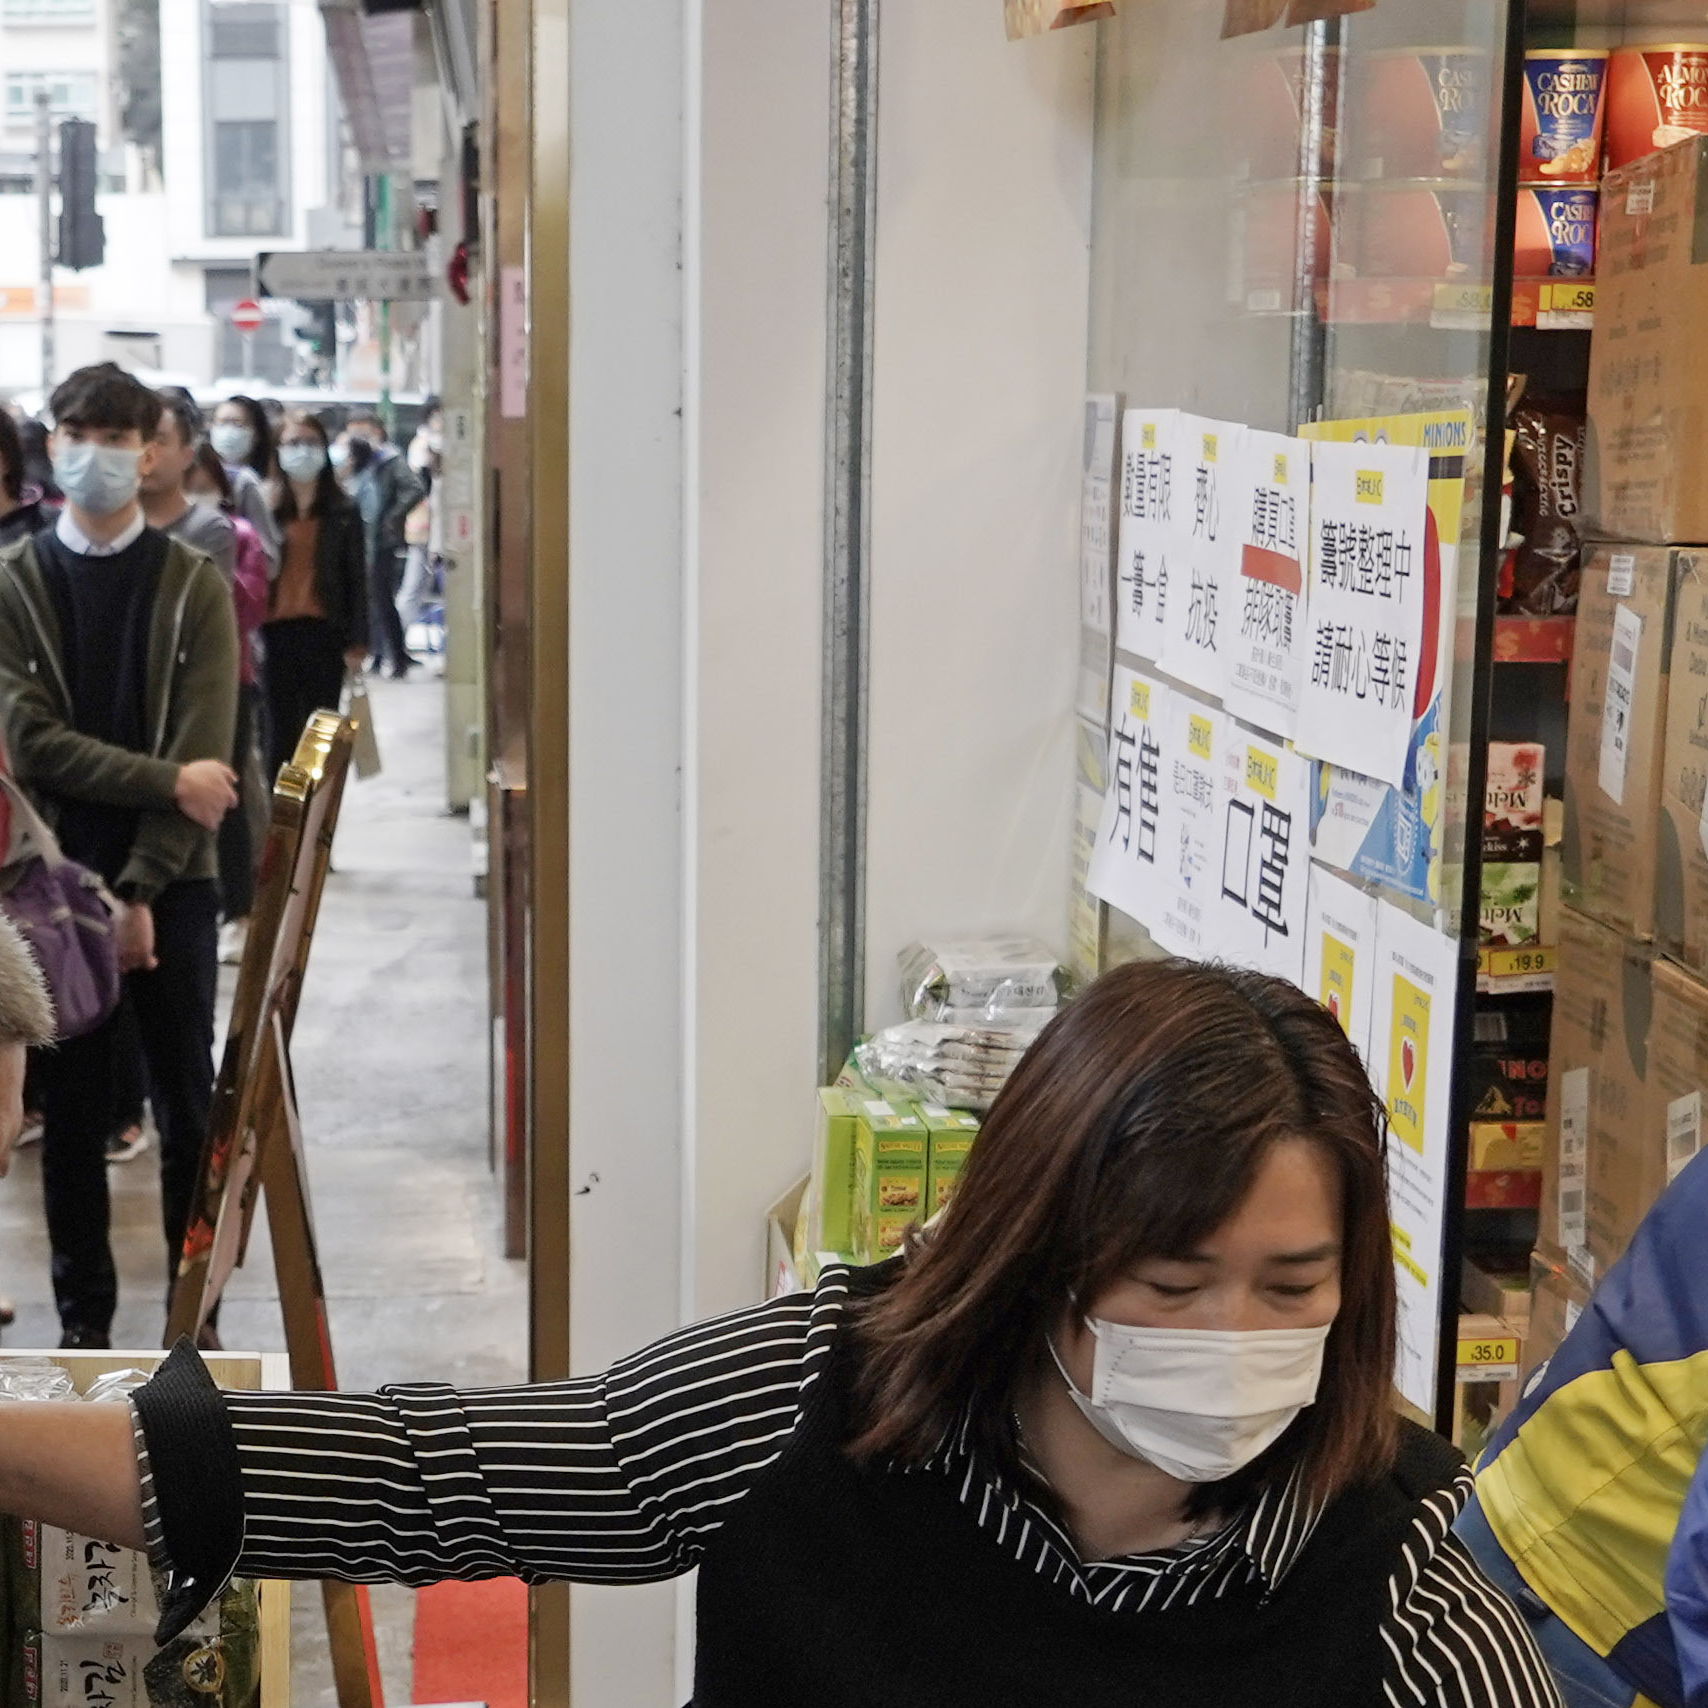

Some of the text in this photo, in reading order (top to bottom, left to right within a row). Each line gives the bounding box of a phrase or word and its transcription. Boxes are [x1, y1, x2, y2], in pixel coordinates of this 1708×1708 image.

[1423, 421, 1467, 449] MINIONS
[1551, 433, 1577, 519] Crispy
[1123, 451, 1173, 523] 數量有限
[1192, 461, 1220, 542] 齊心
[1319, 518, 1412, 605] 籌號整理中
[1184, 568, 1220, 653] 抗疫
[1310, 619, 1408, 713] 請耐心等候
[1108, 711, 1162, 865] 有售
[1221, 796, 1293, 949] 口罩
